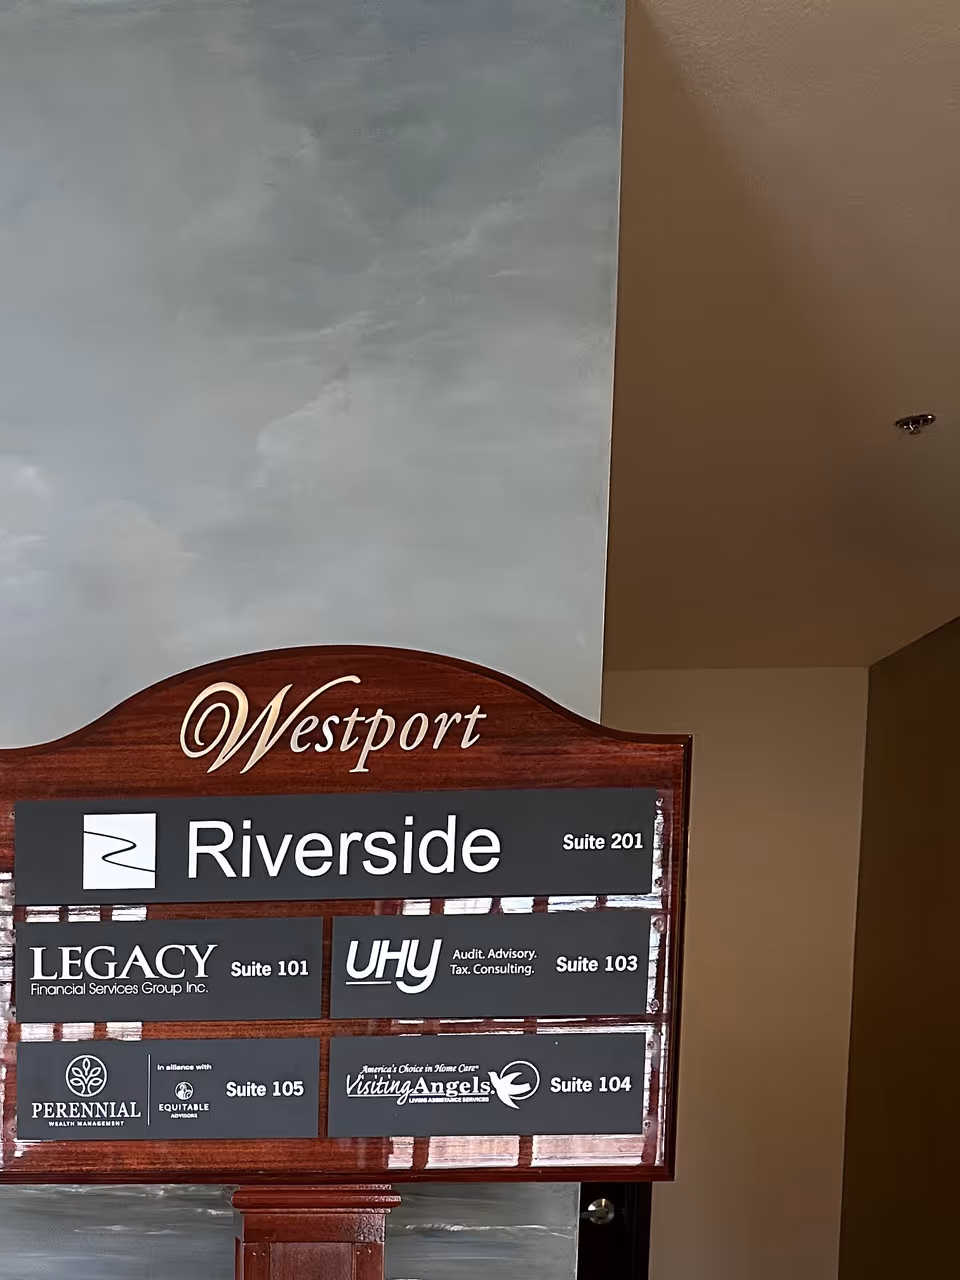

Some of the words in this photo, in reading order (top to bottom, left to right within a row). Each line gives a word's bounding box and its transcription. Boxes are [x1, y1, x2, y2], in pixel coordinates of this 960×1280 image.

[180, 675, 487, 774] Westport
[188, 814, 501, 879] Riverside
[562, 833, 606, 850] Suite
[610, 832, 643, 849] 201
[29, 944, 219, 981] LEGACY
[452, 948, 486, 960] Audit.
[487, 948, 538, 962] Advisory.
[230, 960, 272, 977] Suite
[278, 960, 309, 976] 101
[449, 964, 471, 975] Tax.
[472, 962, 535, 977] Consulting.
[555, 956, 599, 973] Suite
[604, 955, 638, 972] 103
[30, 982, 86, 996] Financial
[88, 982, 139, 995] Services
[141, 981, 183, 997] Group
[186, 981, 209, 994] Inc.
[165, 1063, 195, 1071] alliance
[195, 1063, 212, 1071] with
[360, 1063, 397, 1075] America's
[398, 1063, 424, 1074] Choice
[424, 1064, 433, 1073] in
[433, 1063, 457, 1073] Home
[225, 1081, 267, 1098] Suite
[272, 1080, 304, 1097] 105
[550, 1076, 593, 1093] Suite
[598, 1076, 632, 1092] 104
[31, 1101, 142, 1119] PERENNIAL
[158, 1103, 210, 1112] EQUITABLE
